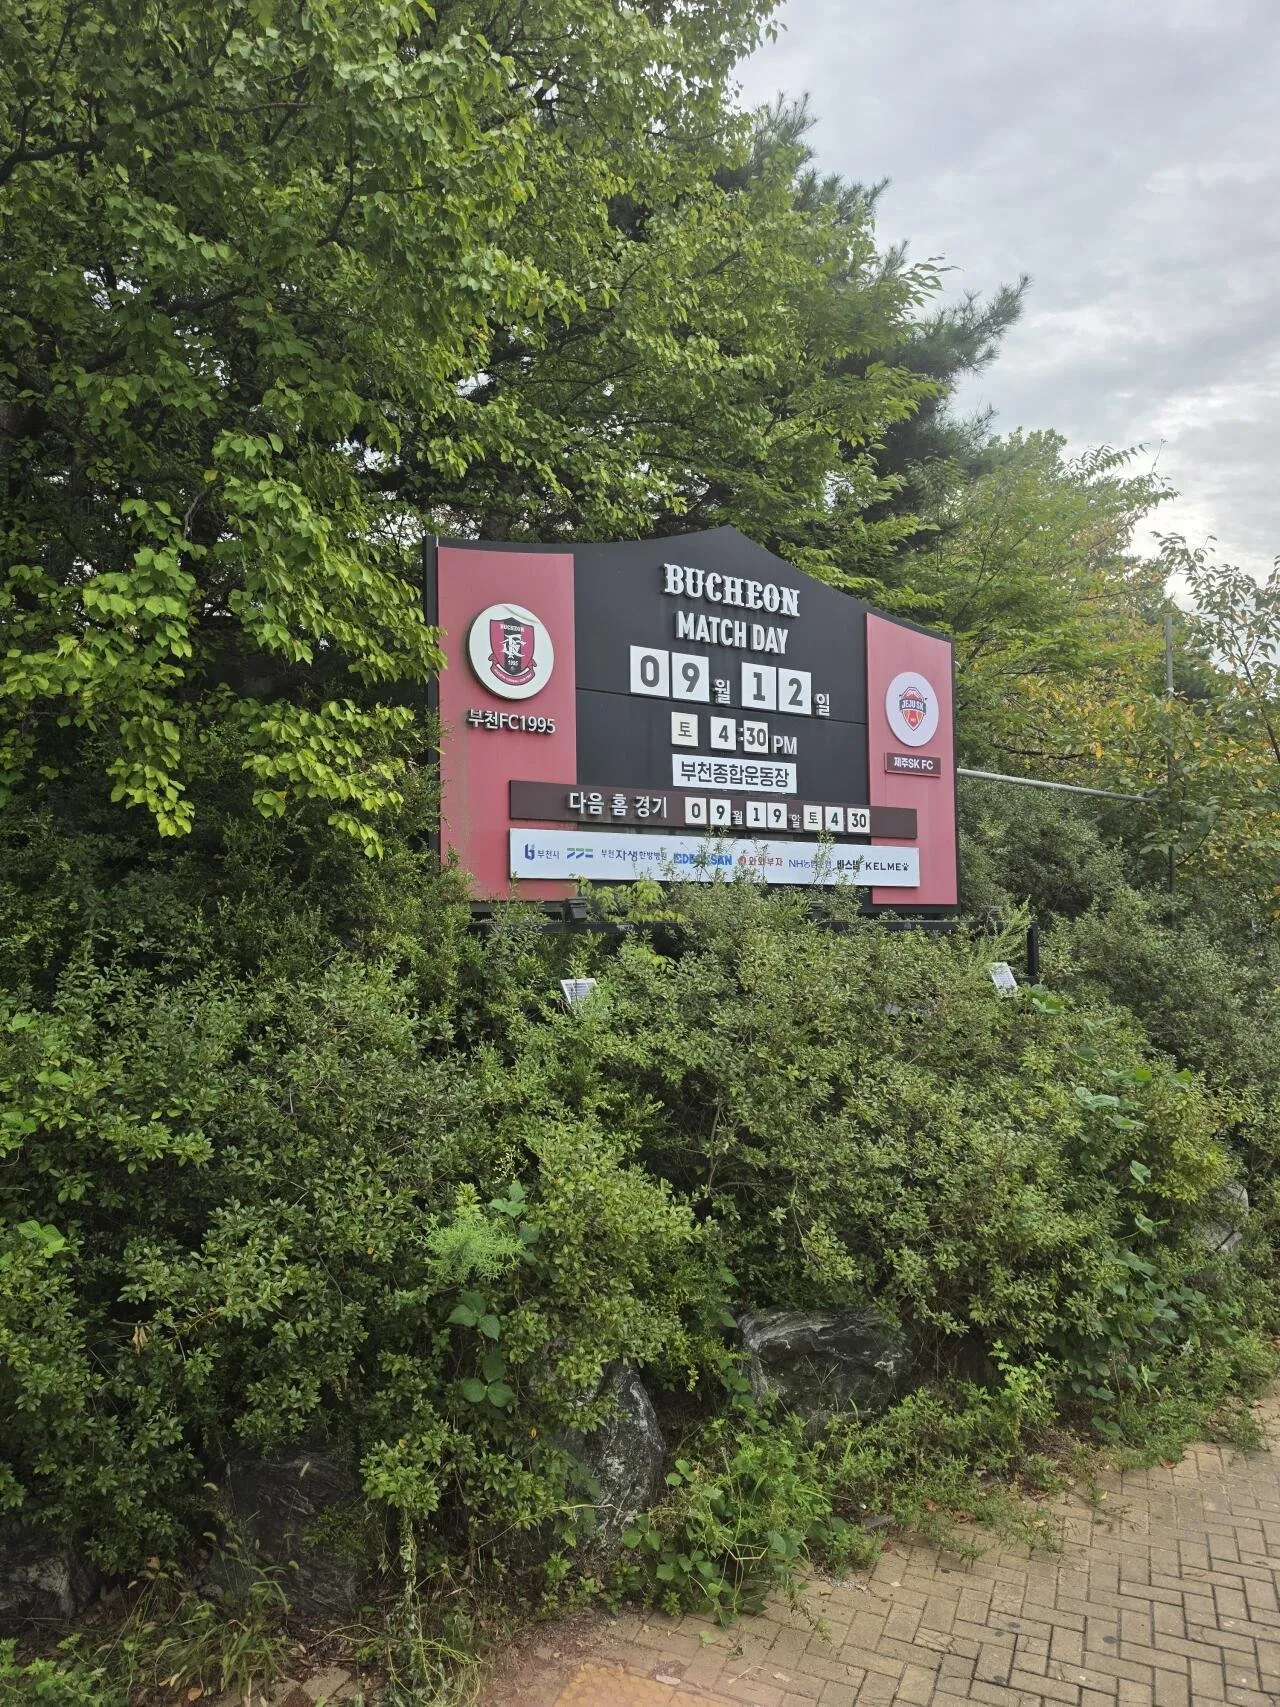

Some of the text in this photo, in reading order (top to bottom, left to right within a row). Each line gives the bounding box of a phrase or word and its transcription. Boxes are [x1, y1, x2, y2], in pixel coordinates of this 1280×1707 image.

[663, 563, 800, 617] BUCHEON
[675, 611, 789, 655] MATCH DAY
[468, 708, 556, 734] 부천FC1995
[678, 721, 693, 738] 토
[771, 735, 798, 755] PM
[680, 760, 790, 788] 부천종합운동장
[921, 759, 934, 770] FC
[569, 791, 605, 815] 다음
[611, 793, 629, 816] 홈
[635, 795, 667, 818] 경기
[808, 811, 819, 825] 토
[537, 849, 560, 860] 부천시
[865, 861, 902, 872] KELME
